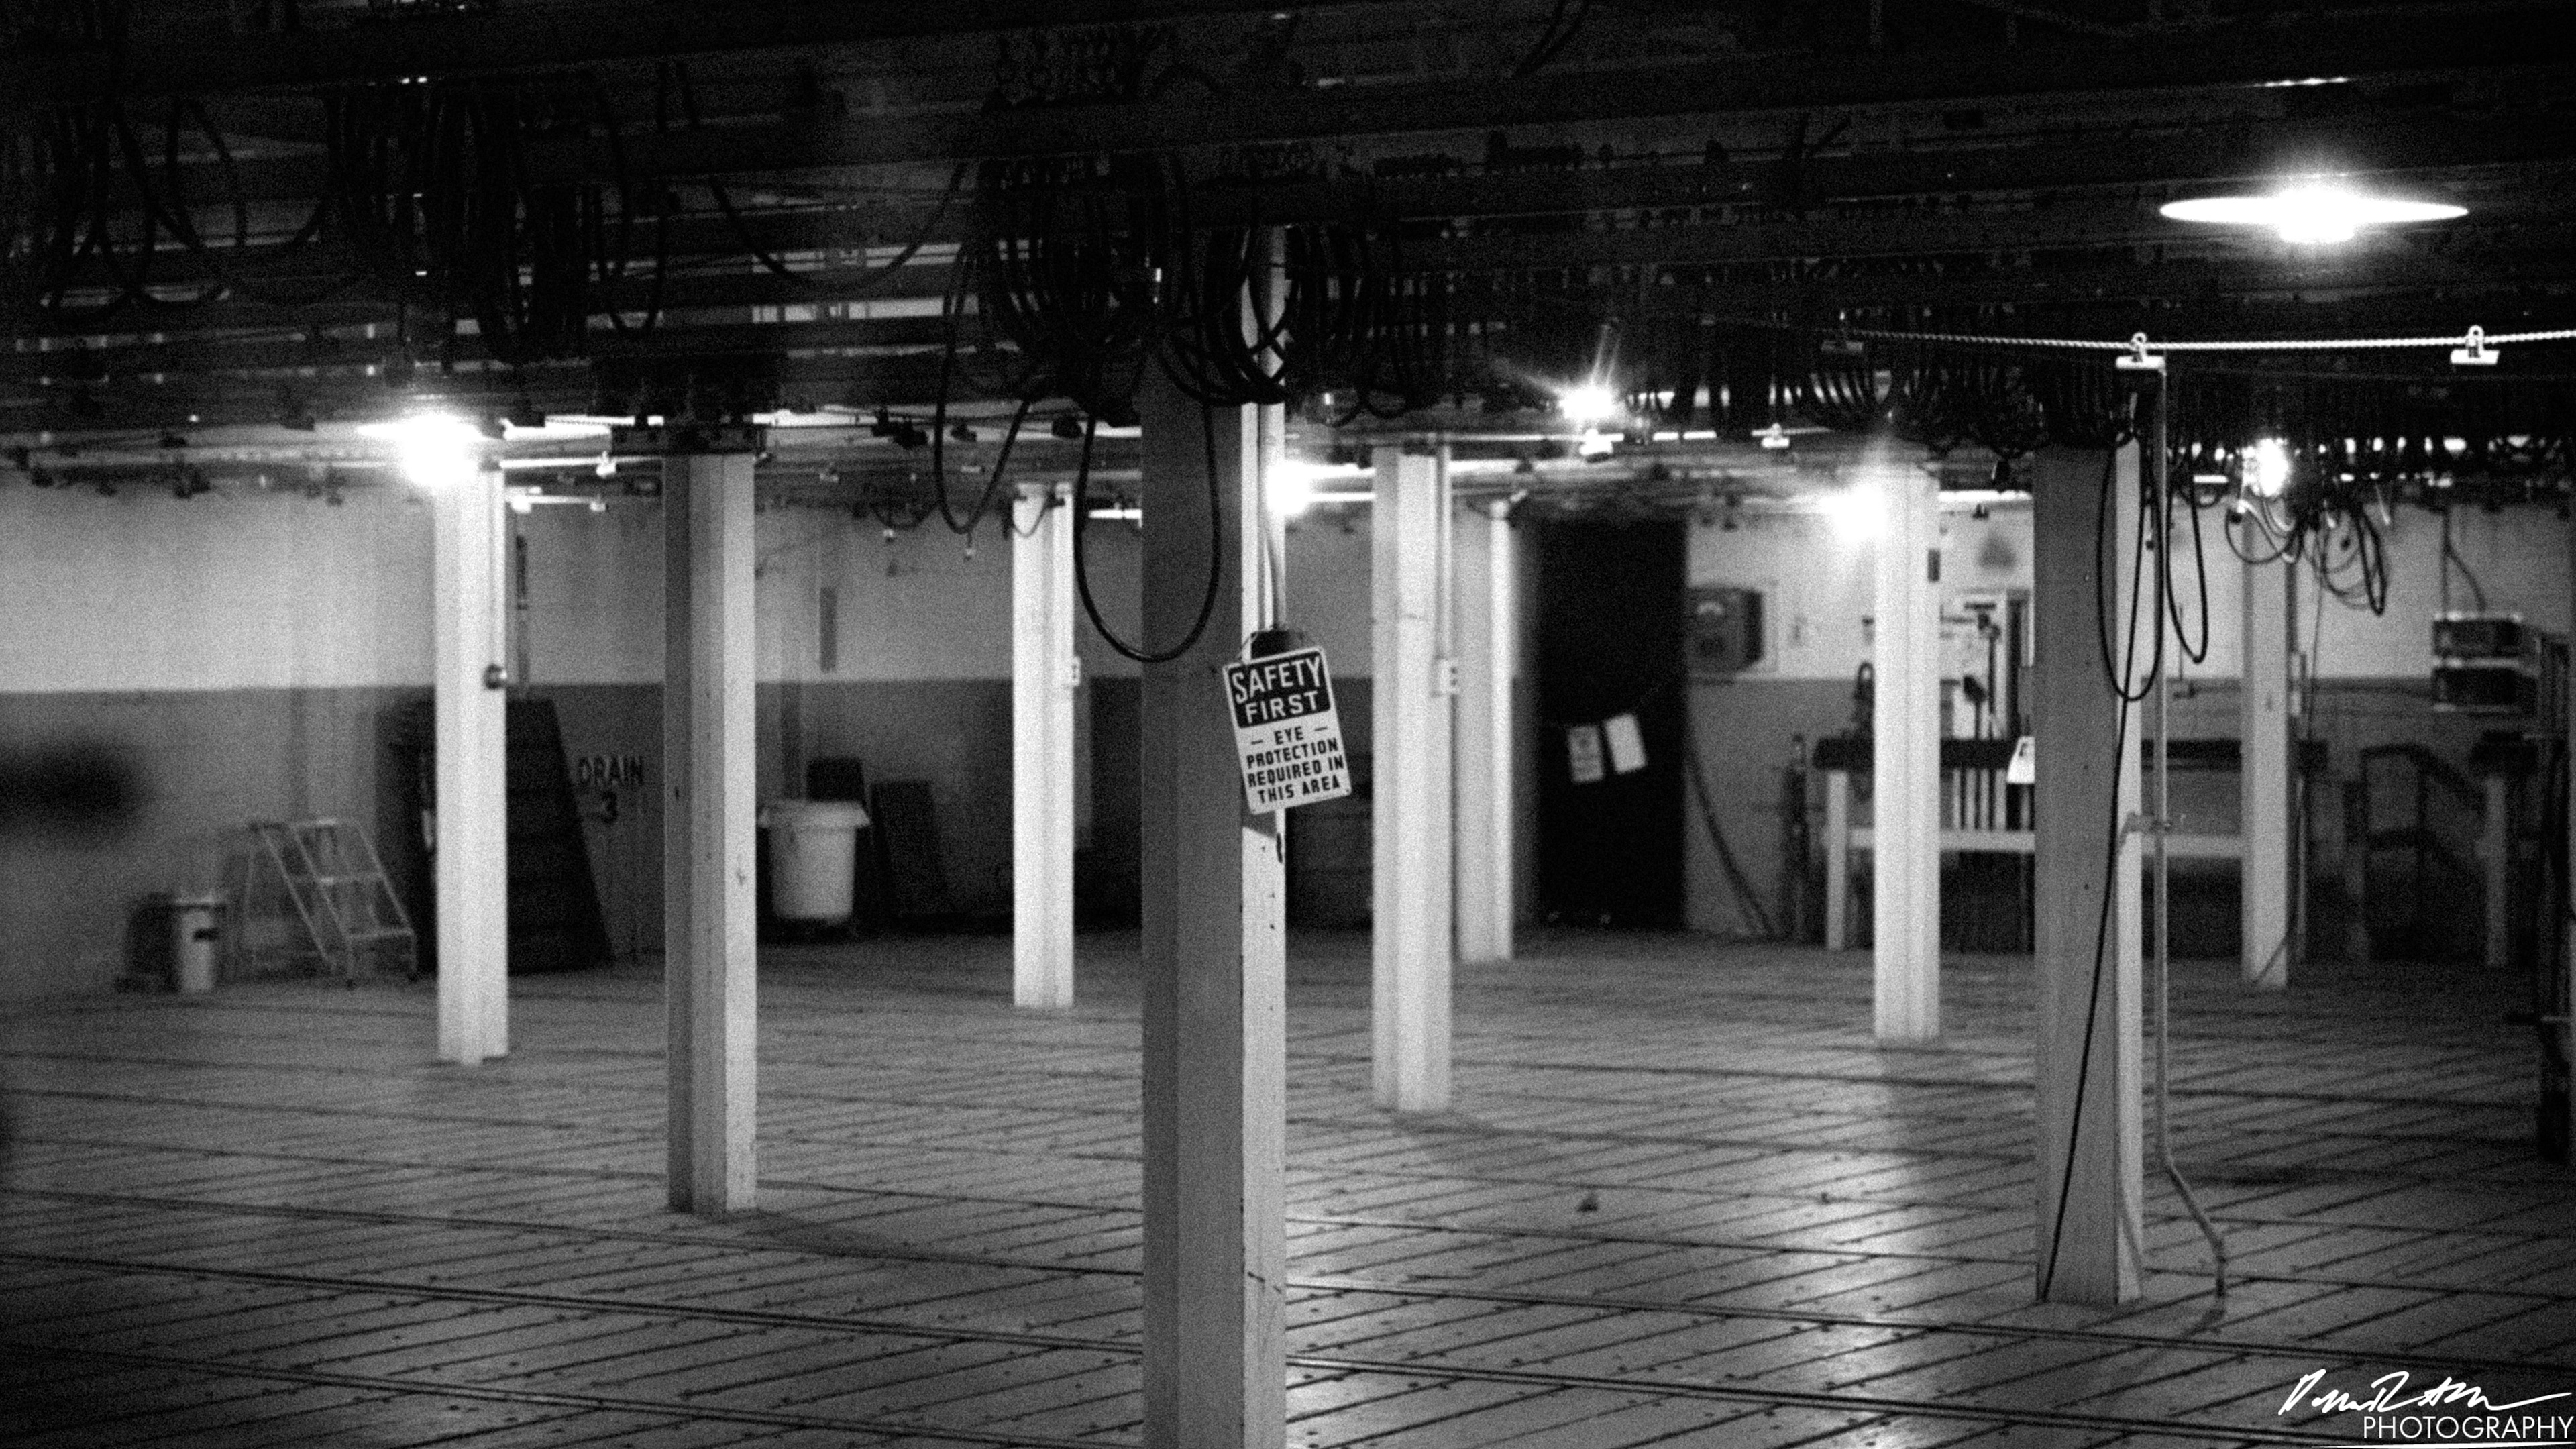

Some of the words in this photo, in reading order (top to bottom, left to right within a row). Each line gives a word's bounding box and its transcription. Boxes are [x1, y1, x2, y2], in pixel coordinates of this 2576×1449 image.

[1232, 655, 1321, 704] SAFETY
[1245, 690, 1318, 724] FIRST
[1274, 726, 1304, 745] EYE
[1246, 738, 1338, 769] PROTECTION
[578, 755, 645, 786] DRAIN
[1247, 759, 1322, 787] REQUIRED
[1328, 755, 1343, 771] IN
[1258, 784, 1294, 804] THIS
[1302, 775, 1340, 796] AREA
[601, 790, 619, 825] 3
